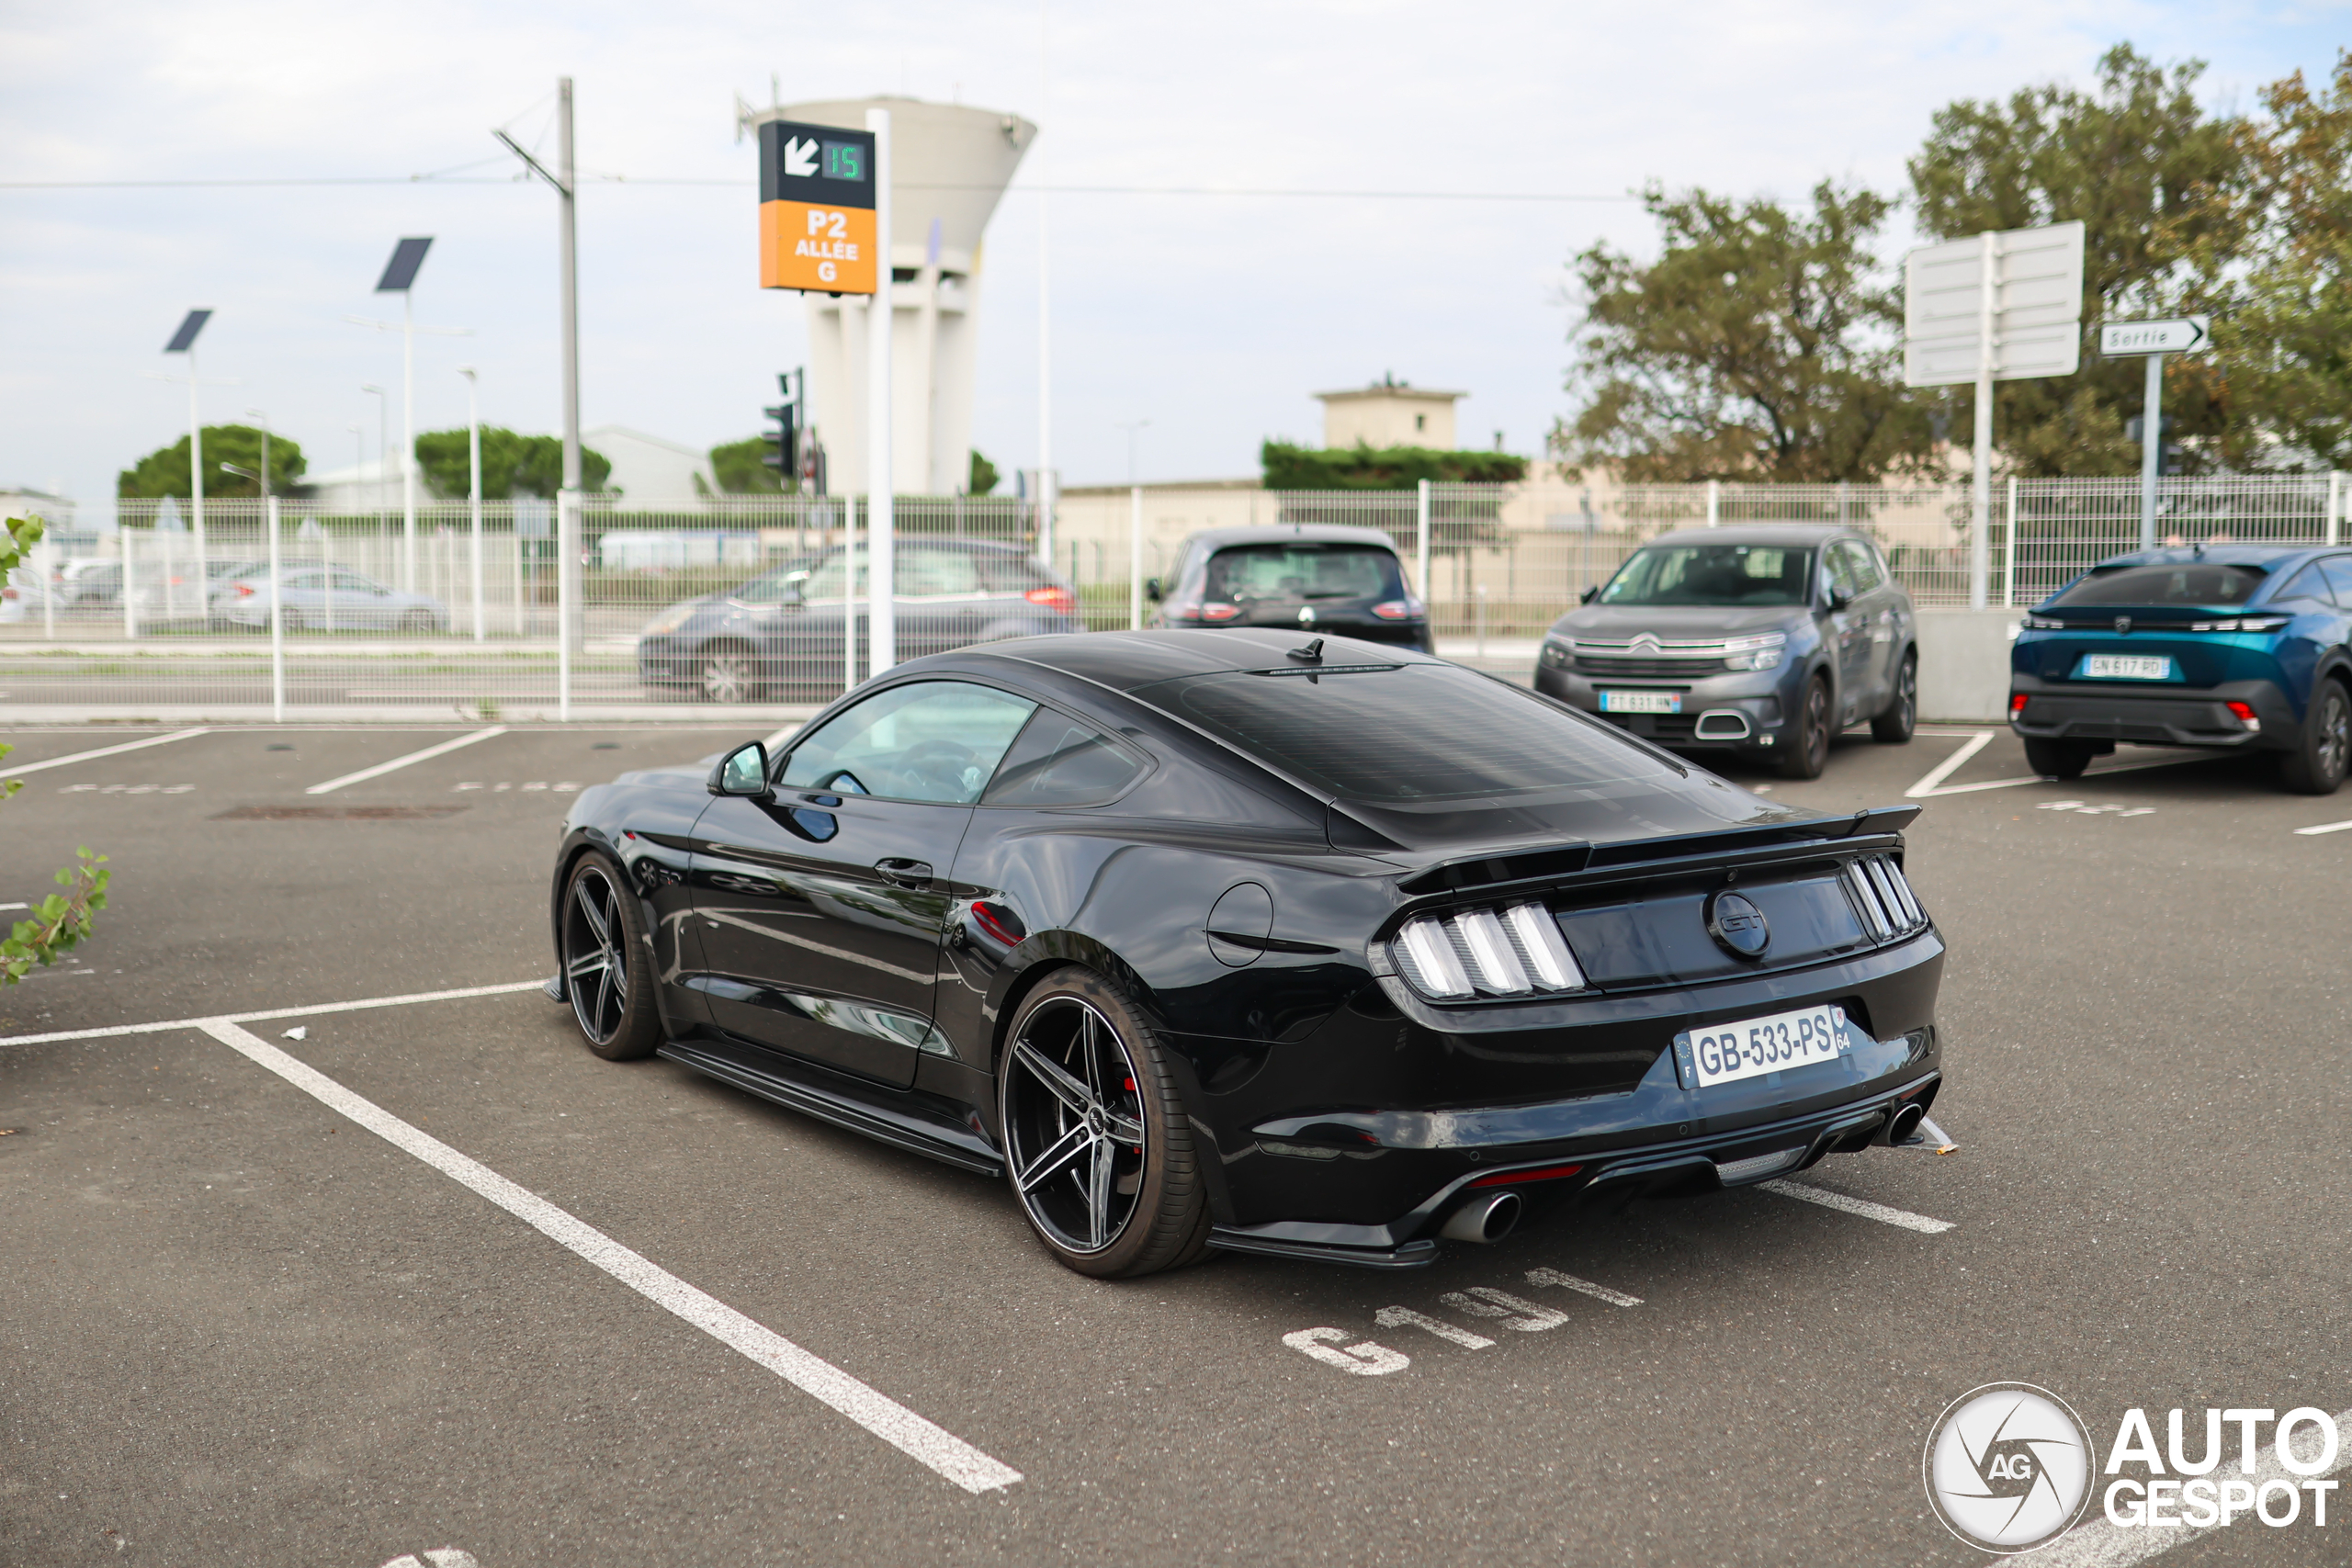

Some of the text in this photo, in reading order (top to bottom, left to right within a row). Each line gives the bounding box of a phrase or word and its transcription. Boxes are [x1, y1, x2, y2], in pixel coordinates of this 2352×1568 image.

[831, 147, 859, 178] 15
[807, 209, 847, 239] P2
[795, 239, 858, 262] ALLÉE
[818, 262, 837, 282] G
[2109, 327, 2168, 346] Sortie
[1721, 913, 1760, 932] GT
[1684, 1014, 1850, 1078] F GB-533-PS 64
[1282, 1266, 1645, 1376] G191
